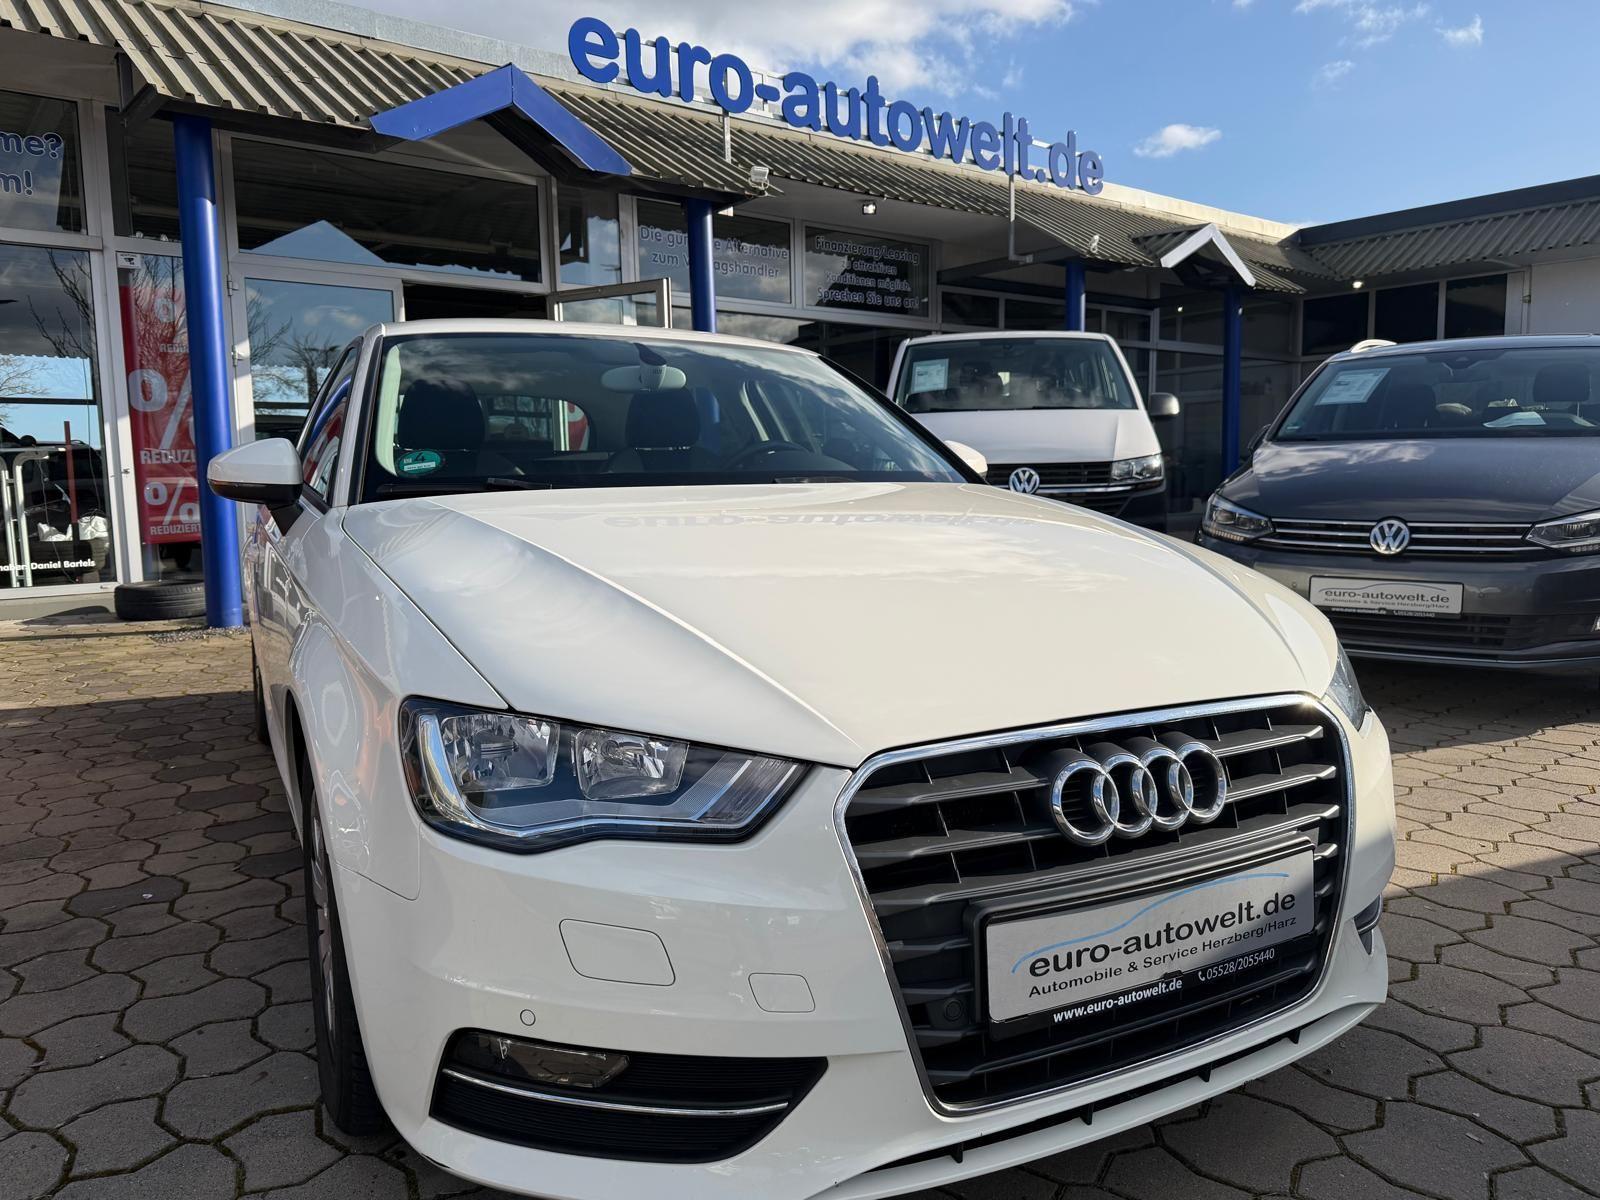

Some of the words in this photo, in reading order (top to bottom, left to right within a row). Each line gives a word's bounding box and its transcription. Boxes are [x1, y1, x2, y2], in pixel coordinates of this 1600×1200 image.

[568, 16, 1104, 195] euro-autowelt.de
[640, 225, 662, 242] Die
[725, 237, 788, 260] Alternative
[651, 251, 679, 265] zum
[853, 260, 897, 275] attraktiven
[824, 271, 876, 288] Konditionen
[817, 286, 864, 303] Sprechen
[865, 291, 882, 306] Sie
[883, 295, 902, 307] uns
[140, 449, 196, 465] REDUZI
[30, 561, 62, 570] Daniel
[63, 558, 97, 568] Bartels
[1324, 590, 1450, 603] euro-autowelt.de
[1028, 892, 1296, 978] euro-autowelt.de
[1028, 967, 1123, 999] Automobile
[1127, 962, 1139, 973] &
[1142, 945, 1199, 970] Service
[1201, 915, 1298, 955] Herzberg/Harz
[1206, 948, 1275, 981] 05528/2055440
[1053, 979, 1184, 1024] www.euro-autowelt.de
